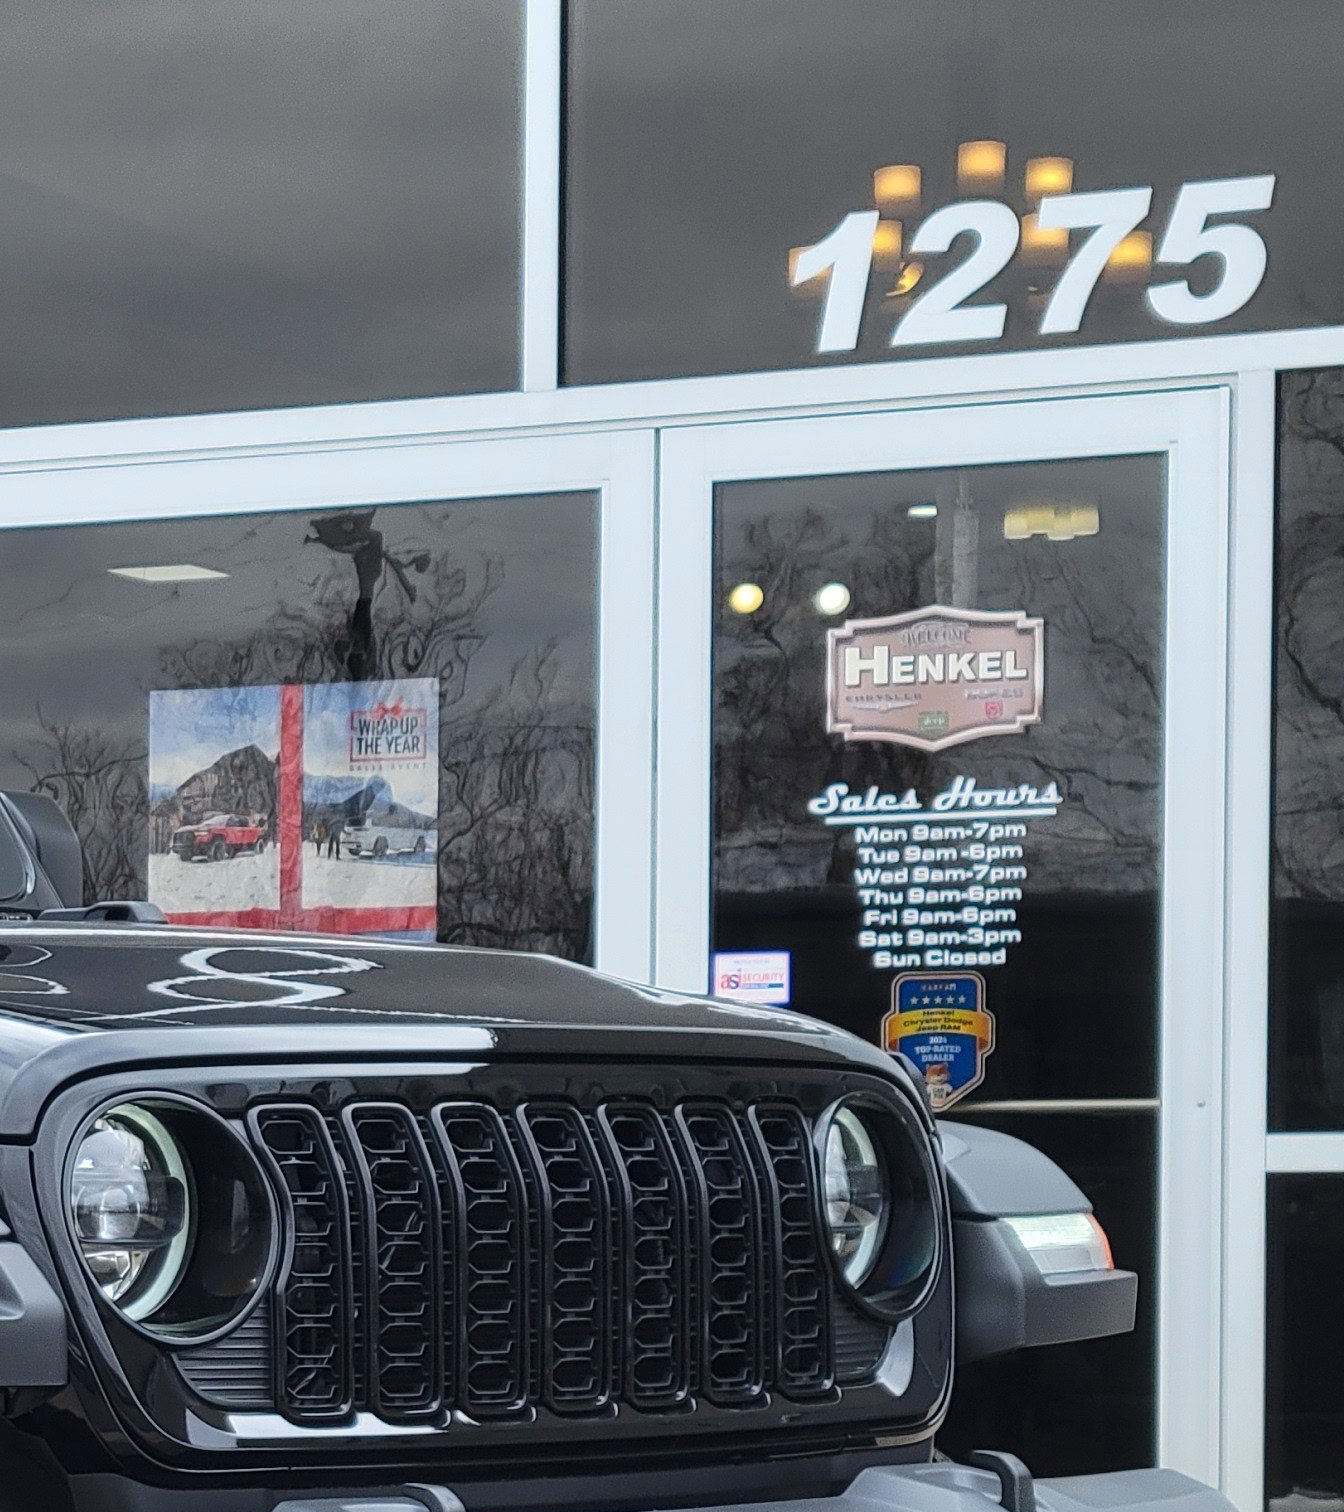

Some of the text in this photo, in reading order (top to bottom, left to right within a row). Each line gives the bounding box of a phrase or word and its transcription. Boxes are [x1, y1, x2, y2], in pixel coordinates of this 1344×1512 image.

[790, 174, 1276, 353] 1275
[844, 645, 1029, 686] HENKEL
[358, 716, 419, 737] WRAP UP
[357, 735, 421, 755] THE YEAR
[807, 774, 1064, 815] Sales Hours
[854, 821, 1027, 843] Mon 9am-7pm
[858, 847, 900, 864] Tue
[854, 863, 1028, 886] Wed 9am-7pm
[858, 885, 1023, 906] Thu 9am-6pm
[863, 906, 1017, 926] Fri 9am-6pm
[858, 926, 1022, 948] Sat 9am-3pm
[872, 947, 1008, 969] Sun Closed
[742, 973, 784, 982] SECURITY
[914, 1045, 962, 1054] TOP-RATED
[921, 1053, 955, 1062] DEALER
